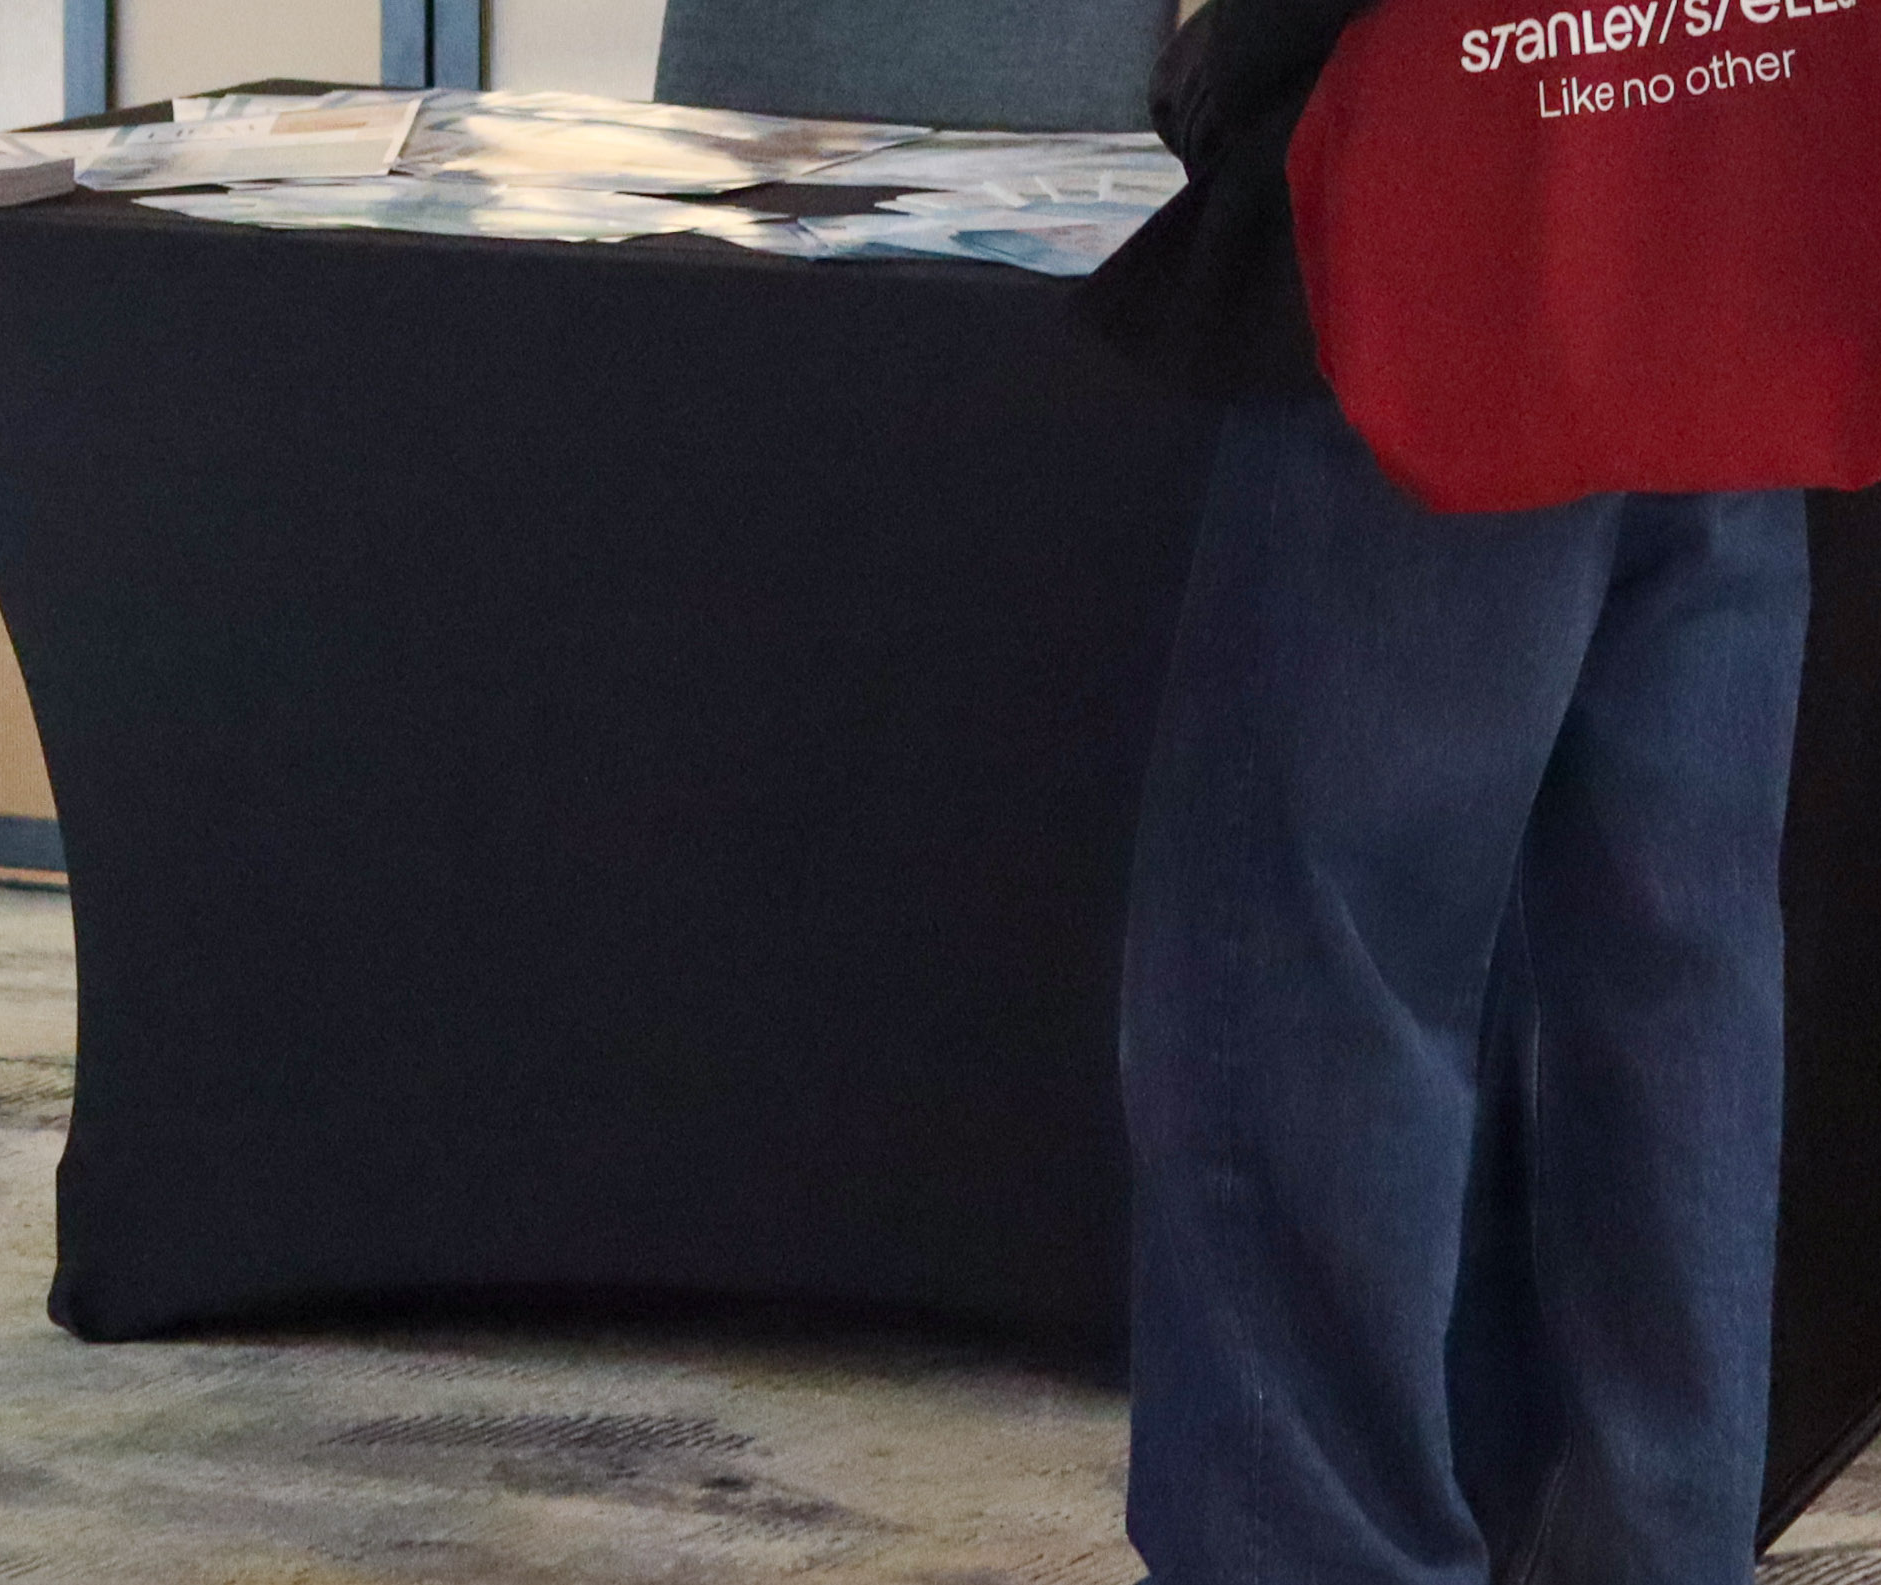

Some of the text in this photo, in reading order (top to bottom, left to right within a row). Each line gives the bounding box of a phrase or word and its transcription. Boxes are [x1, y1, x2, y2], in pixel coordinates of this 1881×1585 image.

[1539, 48, 1796, 118] Like no other
